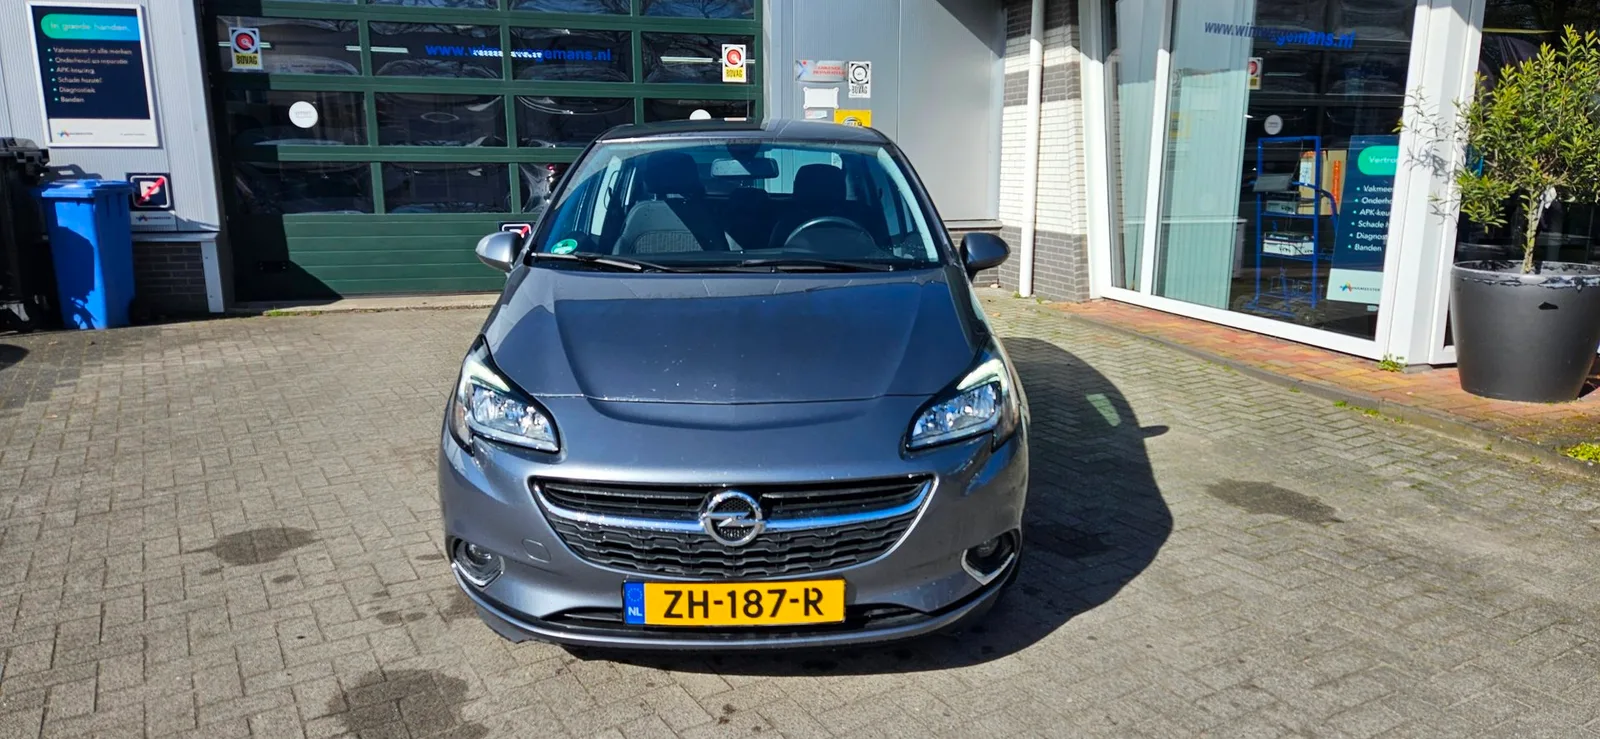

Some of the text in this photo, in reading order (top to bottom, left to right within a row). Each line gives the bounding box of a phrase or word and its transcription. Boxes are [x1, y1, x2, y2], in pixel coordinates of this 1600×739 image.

[63, 22, 90, 31] goede
[235, 54, 258, 65] BOVAG
[726, 69, 743, 78] BOVAG
[851, 85, 868, 94] BOVAG
[1357, 220, 1385, 228] Schade
[1354, 243, 1382, 252] Banden
[663, 587, 824, 619] ZH-187-R
[627, 606, 643, 617] NL
